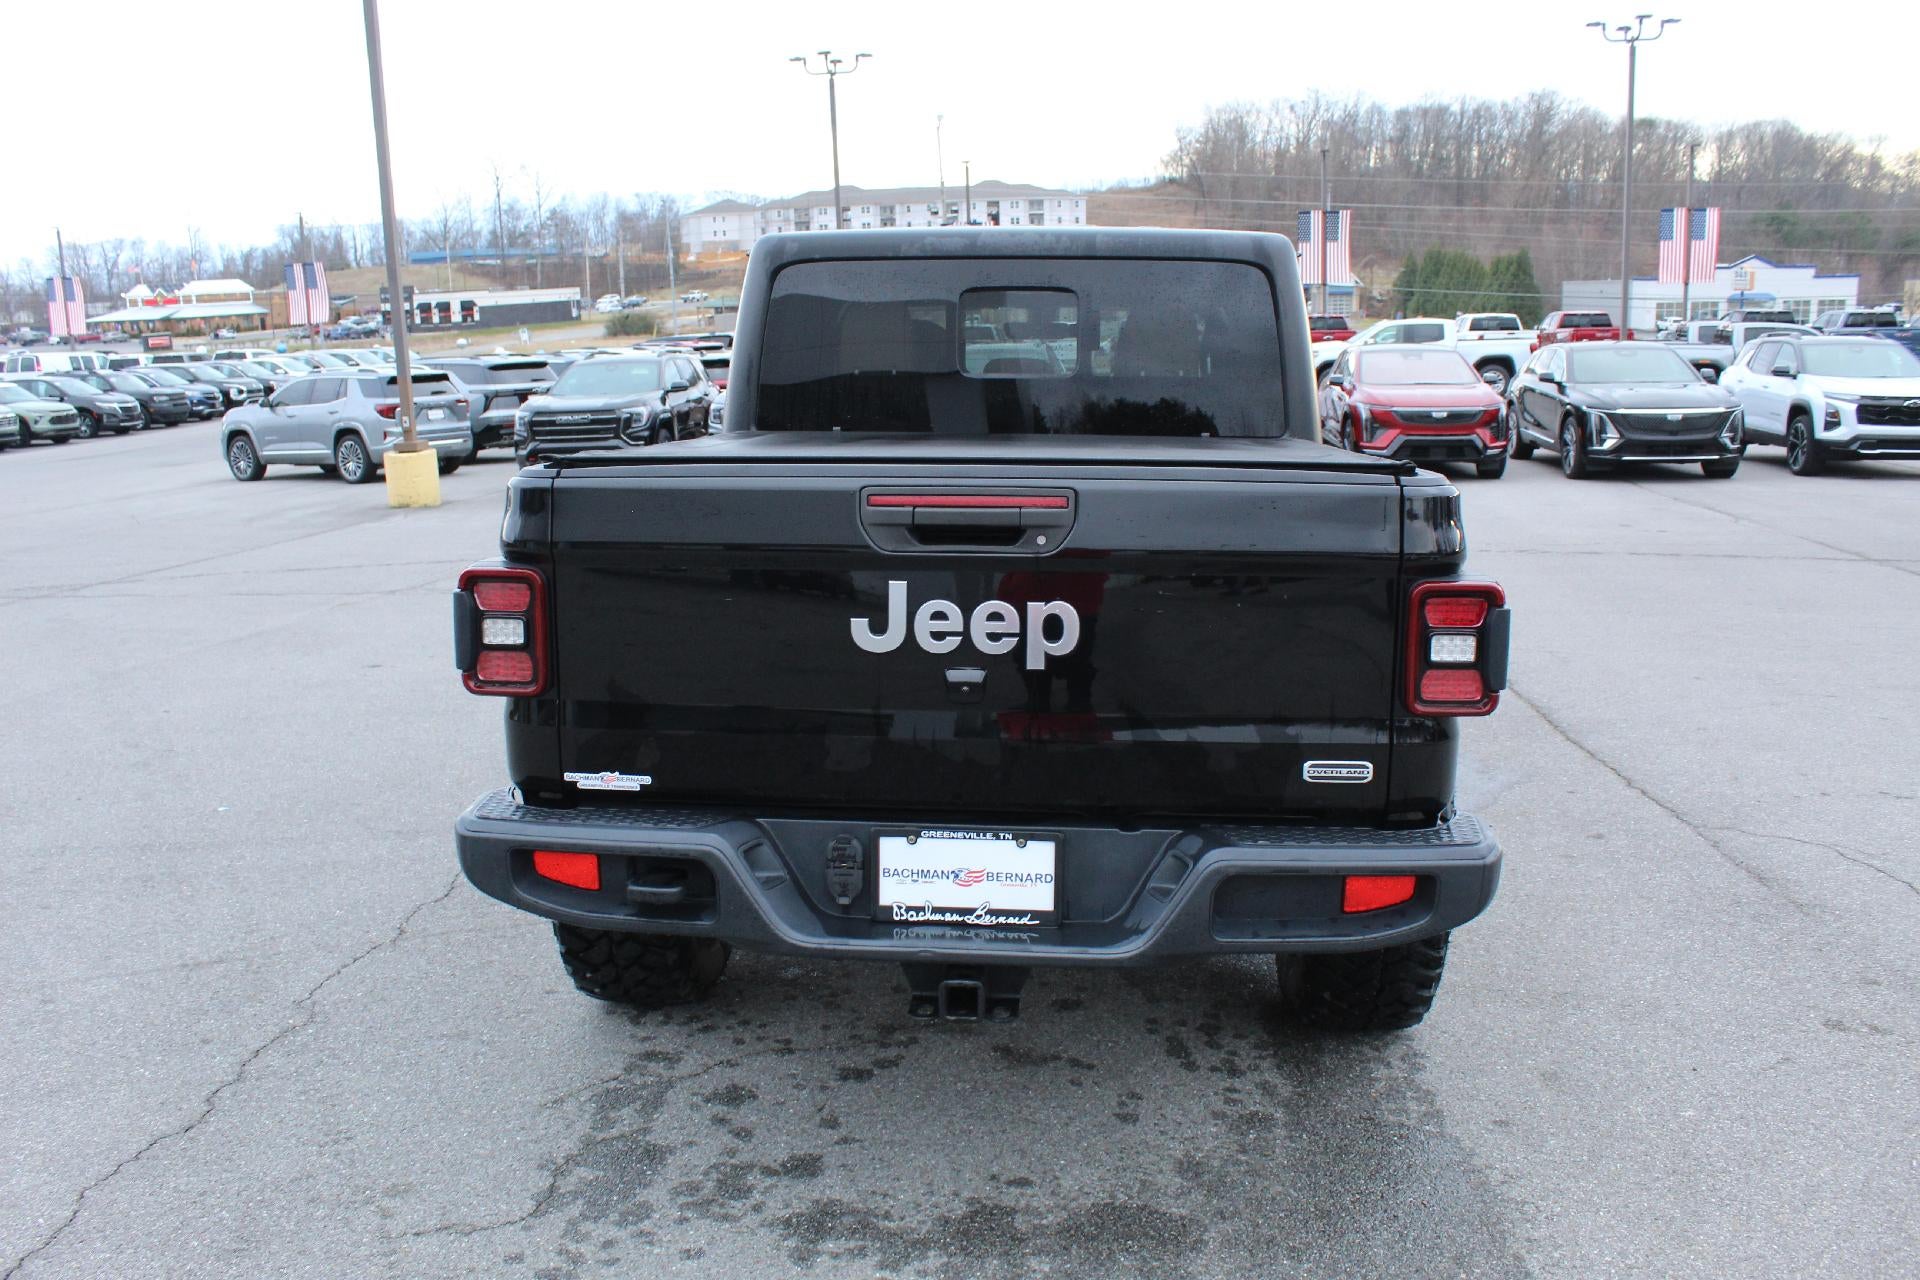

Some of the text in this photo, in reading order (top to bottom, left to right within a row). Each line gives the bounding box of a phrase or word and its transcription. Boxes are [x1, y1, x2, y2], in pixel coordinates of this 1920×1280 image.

[850, 580, 1080, 670] Jeep
[565, 773, 651, 784] BACHMAN BERNARD
[920, 830, 996, 841] GREENEVILLE,
[882, 867, 1054, 884] BACHMAN BERNARD
[892, 900, 1040, 926] Bachman Bernard
